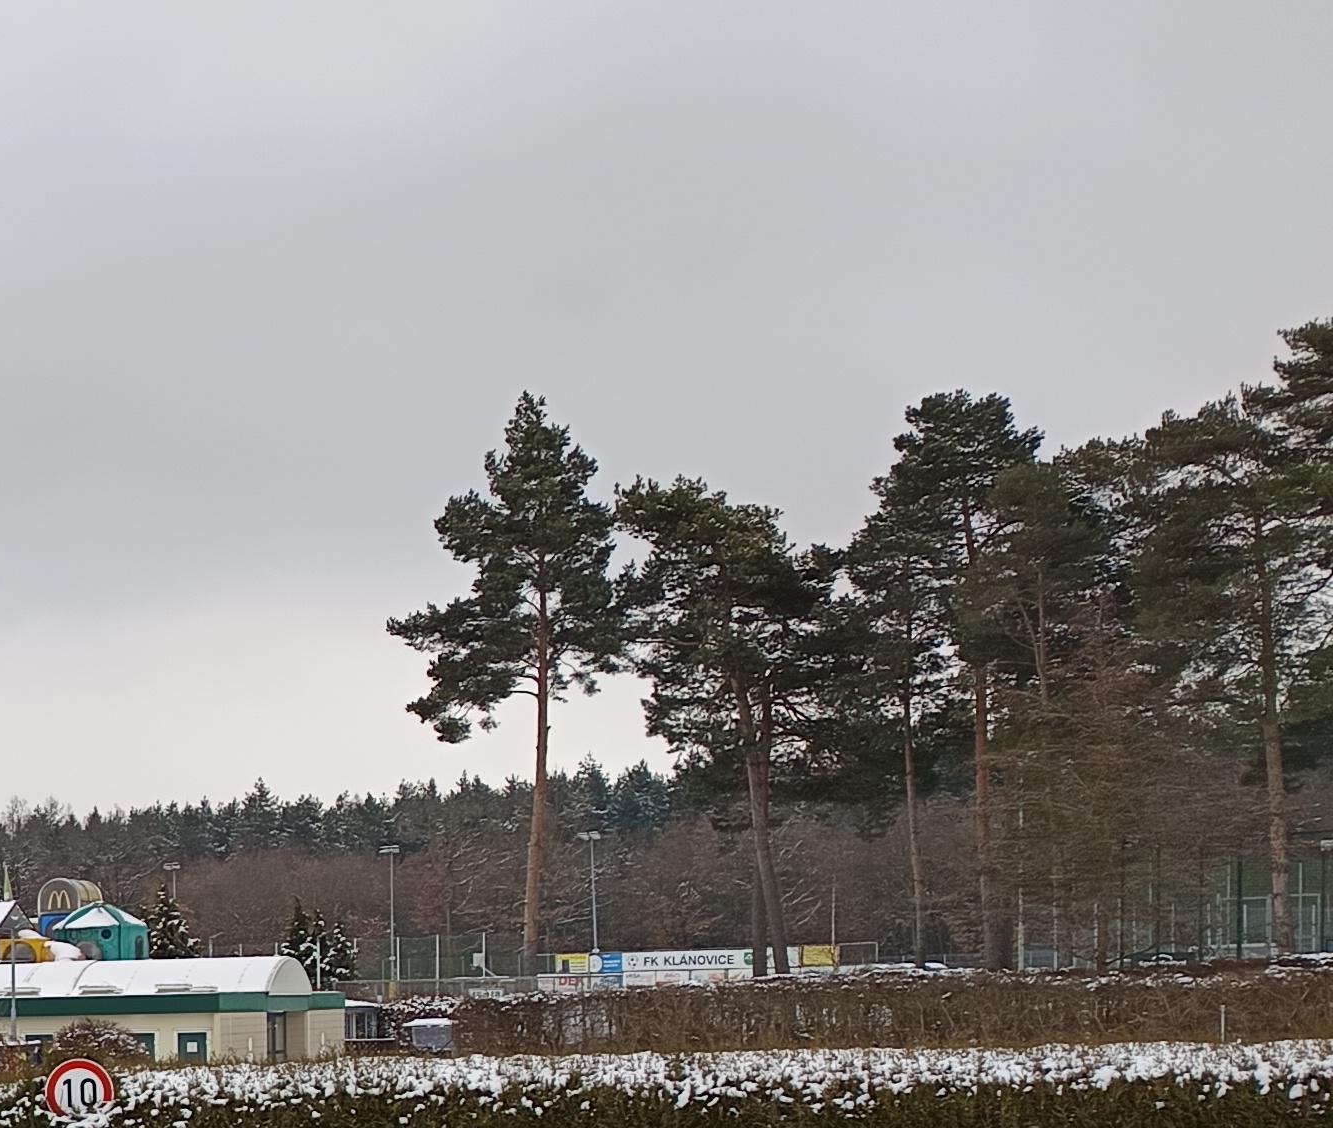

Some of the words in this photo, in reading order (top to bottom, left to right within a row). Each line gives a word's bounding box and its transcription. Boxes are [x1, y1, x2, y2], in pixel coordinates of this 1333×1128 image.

[643, 956, 659, 967] FK
[663, 953, 735, 966] KLÁNOVICE
[63, 1078, 97, 1107] 10
